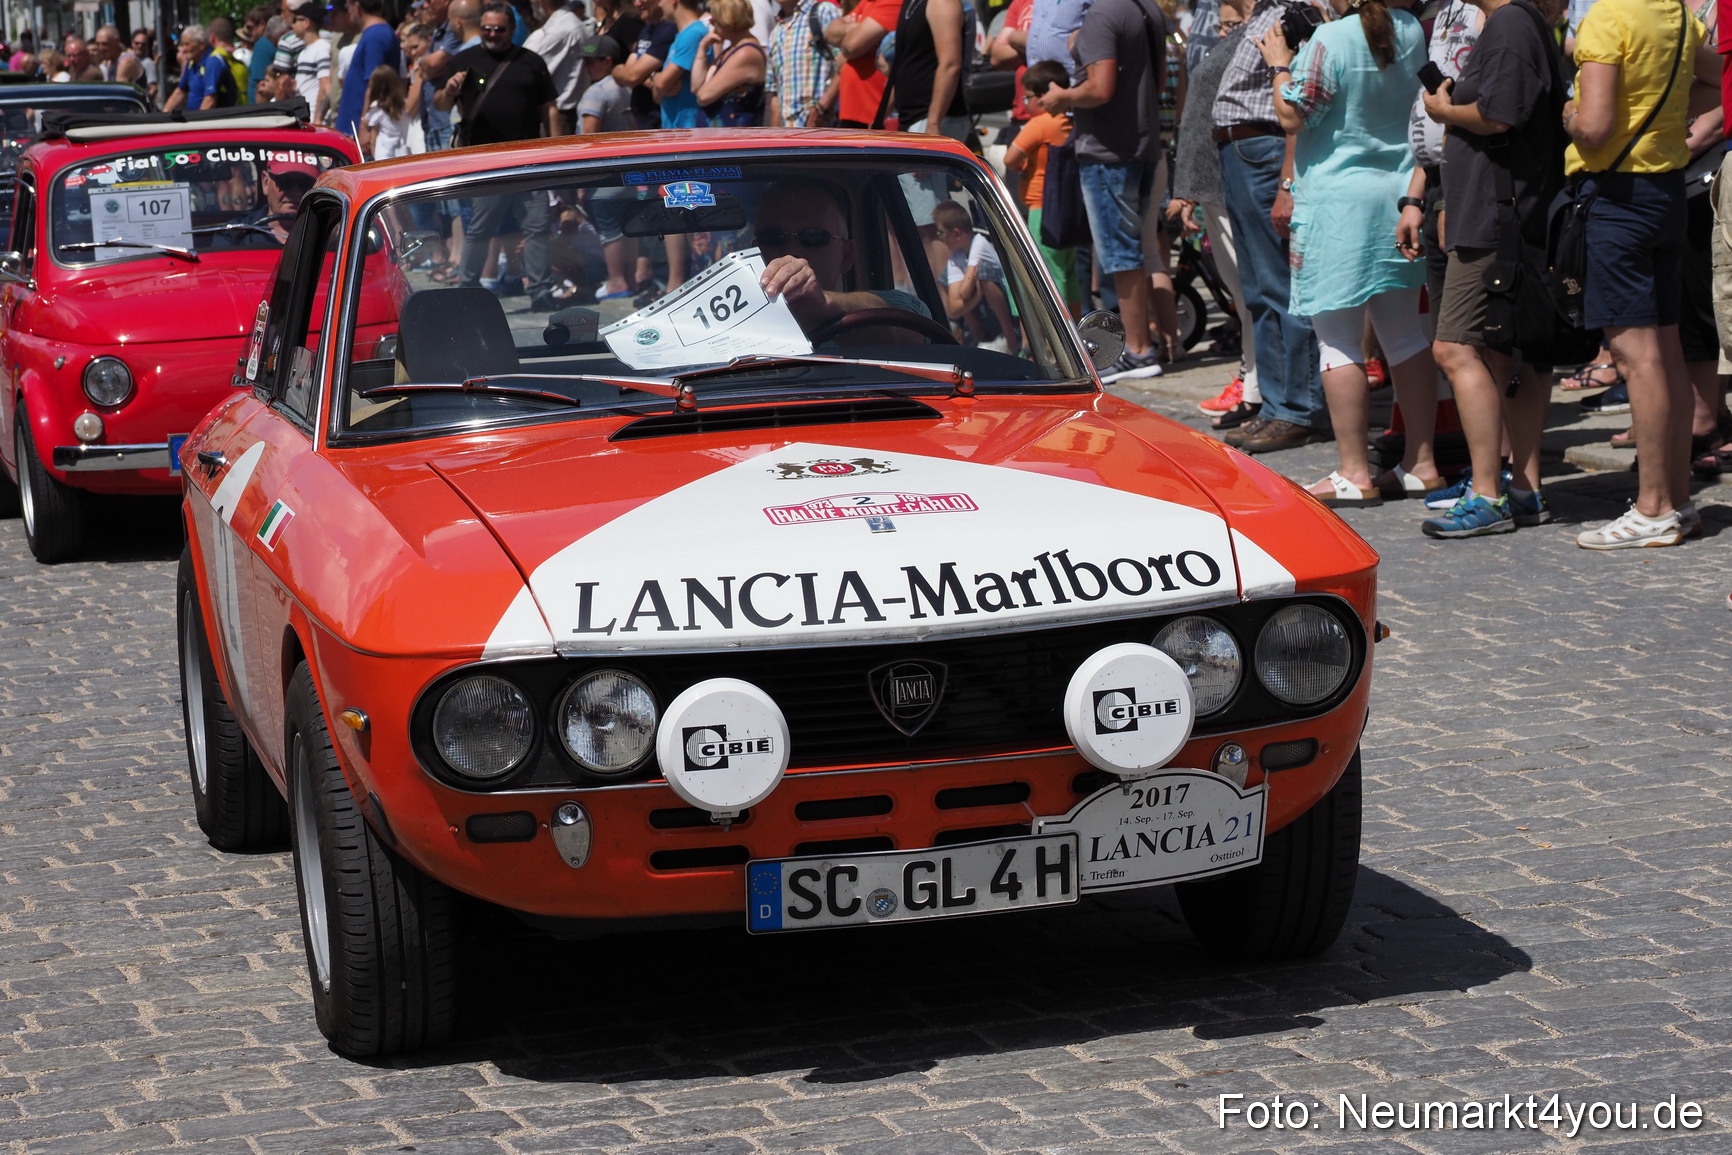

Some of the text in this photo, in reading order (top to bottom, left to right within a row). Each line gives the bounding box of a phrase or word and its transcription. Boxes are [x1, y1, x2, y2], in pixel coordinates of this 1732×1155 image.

[115, 147, 317, 172] Fiat 500 Club Italia
[139, 199, 171, 216] 107
[692, 284, 749, 330] 162
[773, 496, 968, 524] RALLYE MONTE-CARLO
[802, 500, 833, 511] 1973
[852, 496, 875, 505] 2
[572, 549, 1221, 636] LANCIA-Marlboro
[895, 680, 930, 705] LANCIA
[1130, 782, 1190, 810] 2017
[1119, 817, 1132, 826] 14.
[1135, 814, 1154, 825] Sep.
[1163, 812, 1175, 821] 17.
[1177, 809, 1196, 820] Sep.
[1087, 811, 1253, 863] LANCIA 21
[1210, 847, 1245, 864] Osttirol
[1090, 868, 1126, 881] Treffen
[787, 864, 862, 920] SC
[902, 857, 976, 911] GL
[759, 904, 772, 919] D
